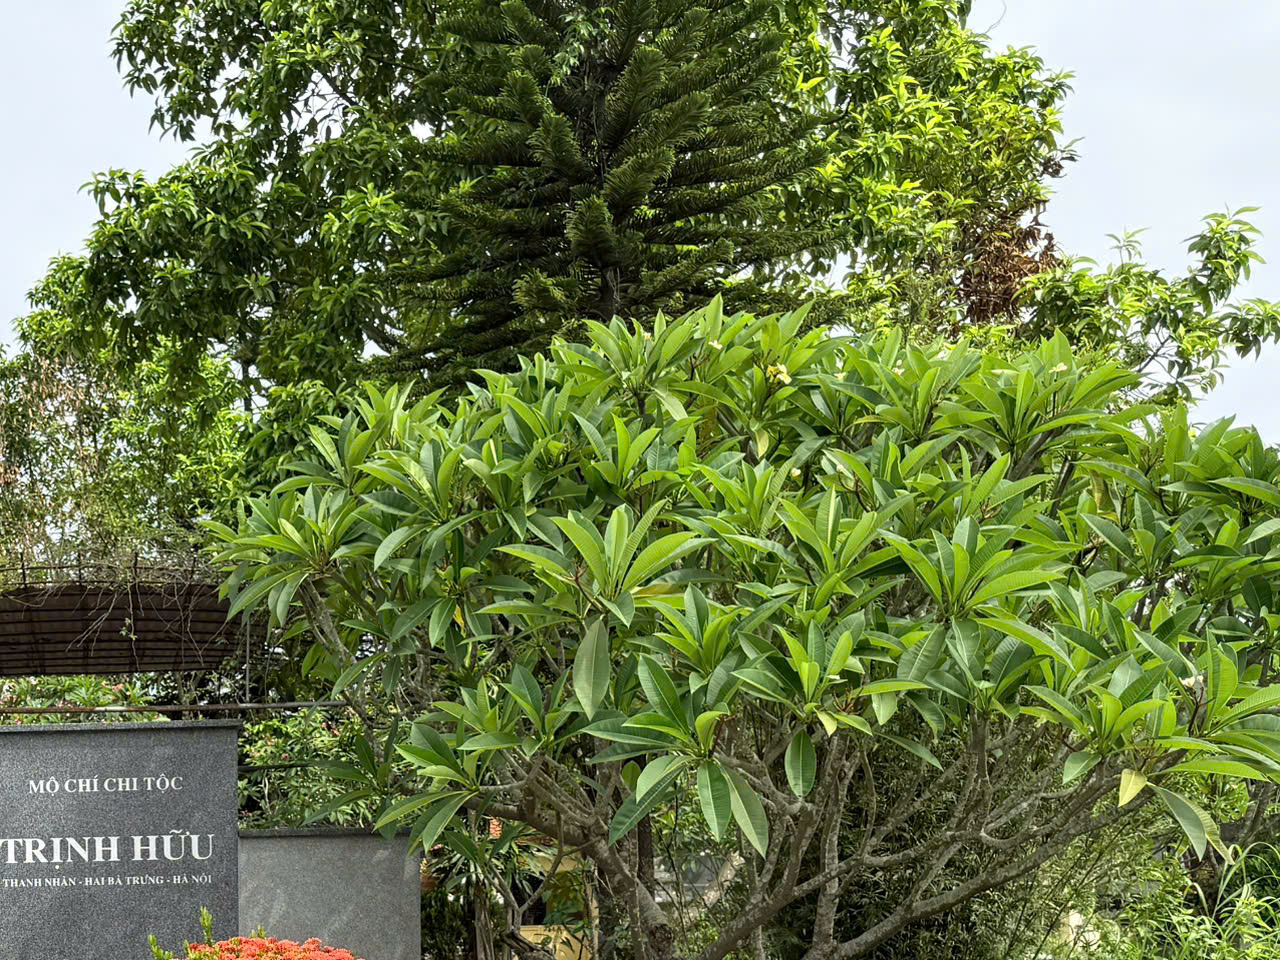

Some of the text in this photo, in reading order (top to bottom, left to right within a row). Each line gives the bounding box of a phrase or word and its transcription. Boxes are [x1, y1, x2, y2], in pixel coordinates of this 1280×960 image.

[29, 773, 183, 796] MỘ CHÍ CHI TỘC
[0, 829, 215, 869] TRỊNH HỮU
[2, 878, 42, 888] THANH
[84, 877, 106, 886] HAI
[107, 875, 123, 885] BÀ
[125, 874, 164, 885] TRƯNG
[172, 873, 189, 884] HÀ
[191, 872, 212, 885] NỘI
